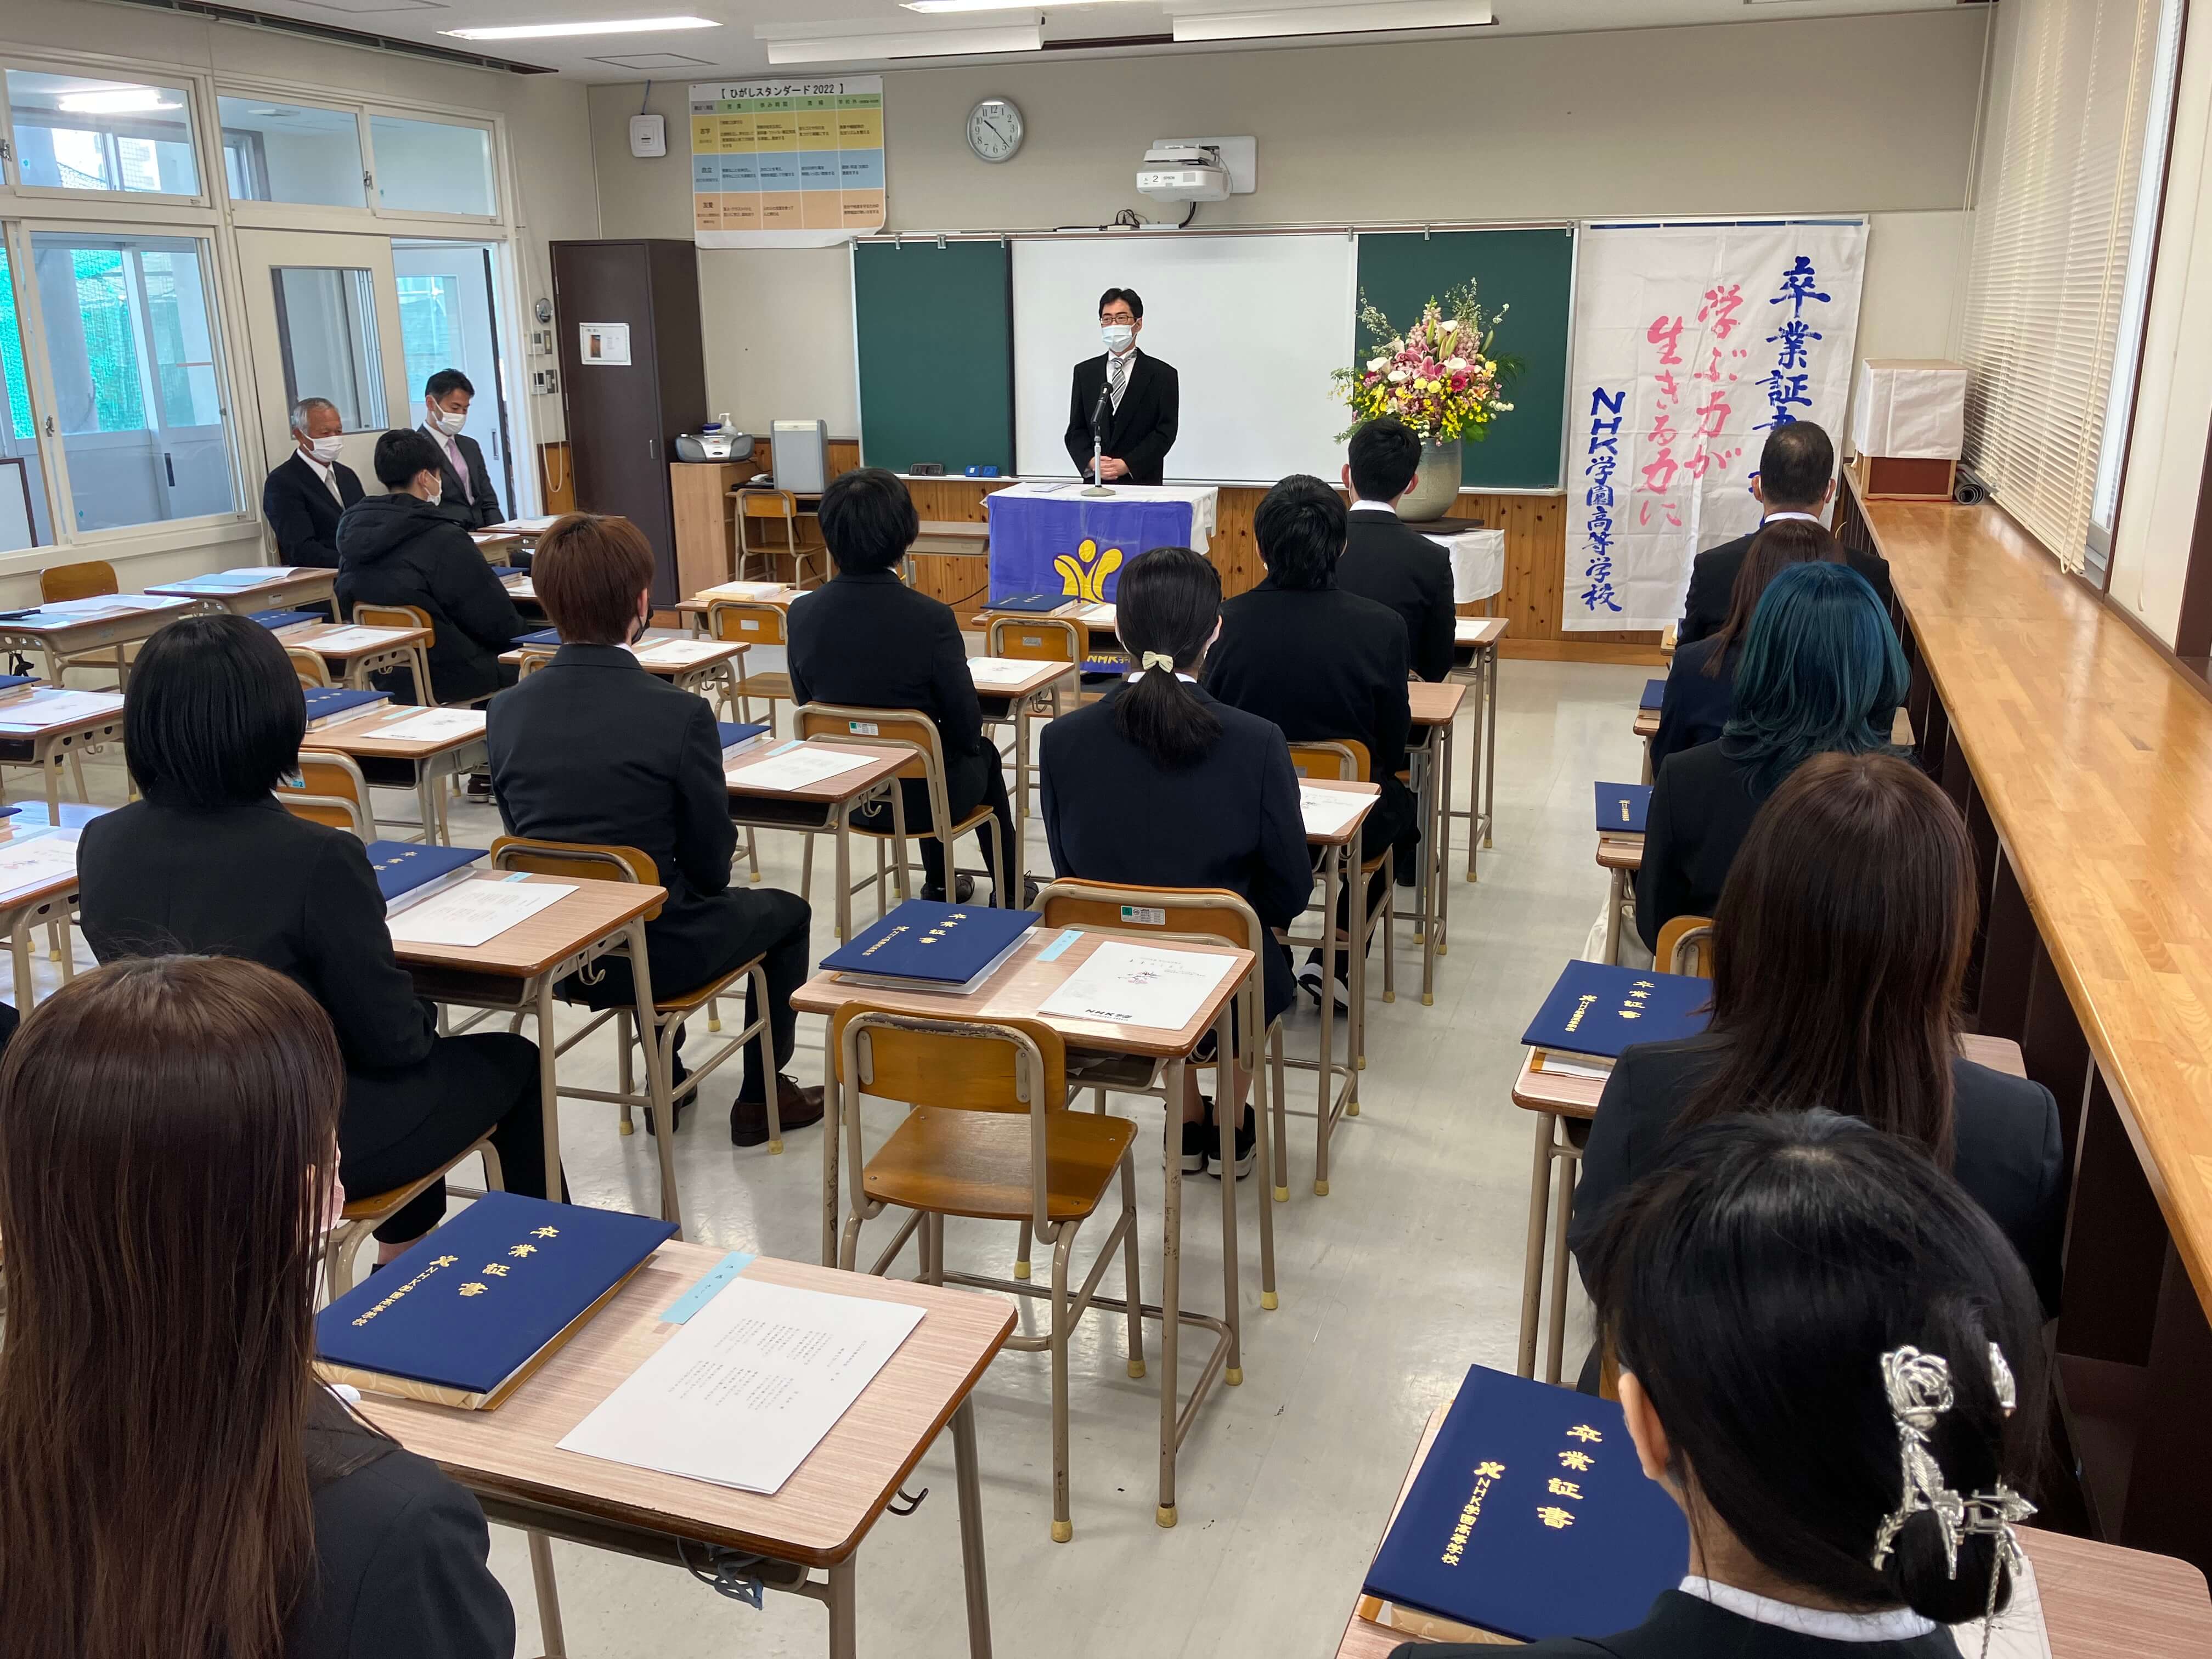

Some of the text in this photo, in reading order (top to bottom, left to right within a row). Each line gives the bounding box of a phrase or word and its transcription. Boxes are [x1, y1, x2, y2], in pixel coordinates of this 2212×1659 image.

[1636, 315, 1685, 526] 生きる力に
[1683, 284, 1747, 479] 学ぶ力が
[458, 1225, 560, 1297] 卒業証書
[1441, 1477, 1491, 1566] NHK学園高等学校
[1536, 1424, 1603, 1530] 卒業証書
